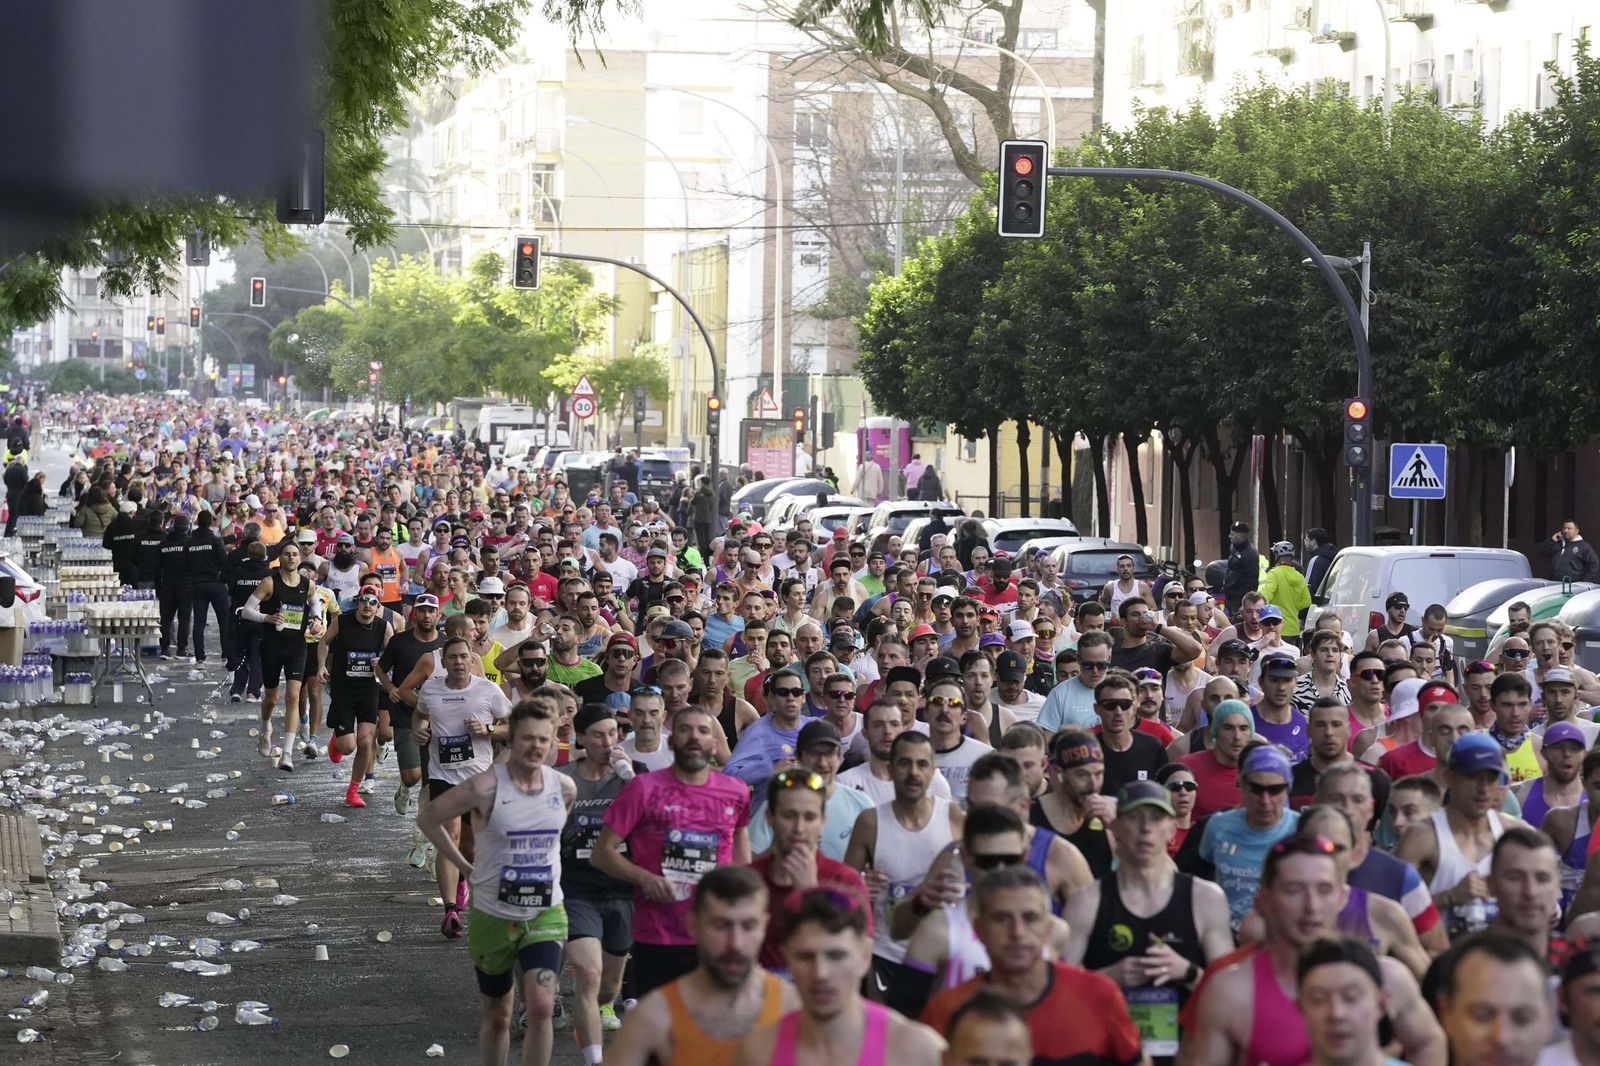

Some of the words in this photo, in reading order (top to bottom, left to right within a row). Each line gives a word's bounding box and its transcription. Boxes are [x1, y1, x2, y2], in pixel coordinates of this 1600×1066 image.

[577, 403, 591, 411] 30
[450, 753, 464, 762] ALE
[507, 895, 543, 906] OLIVER
